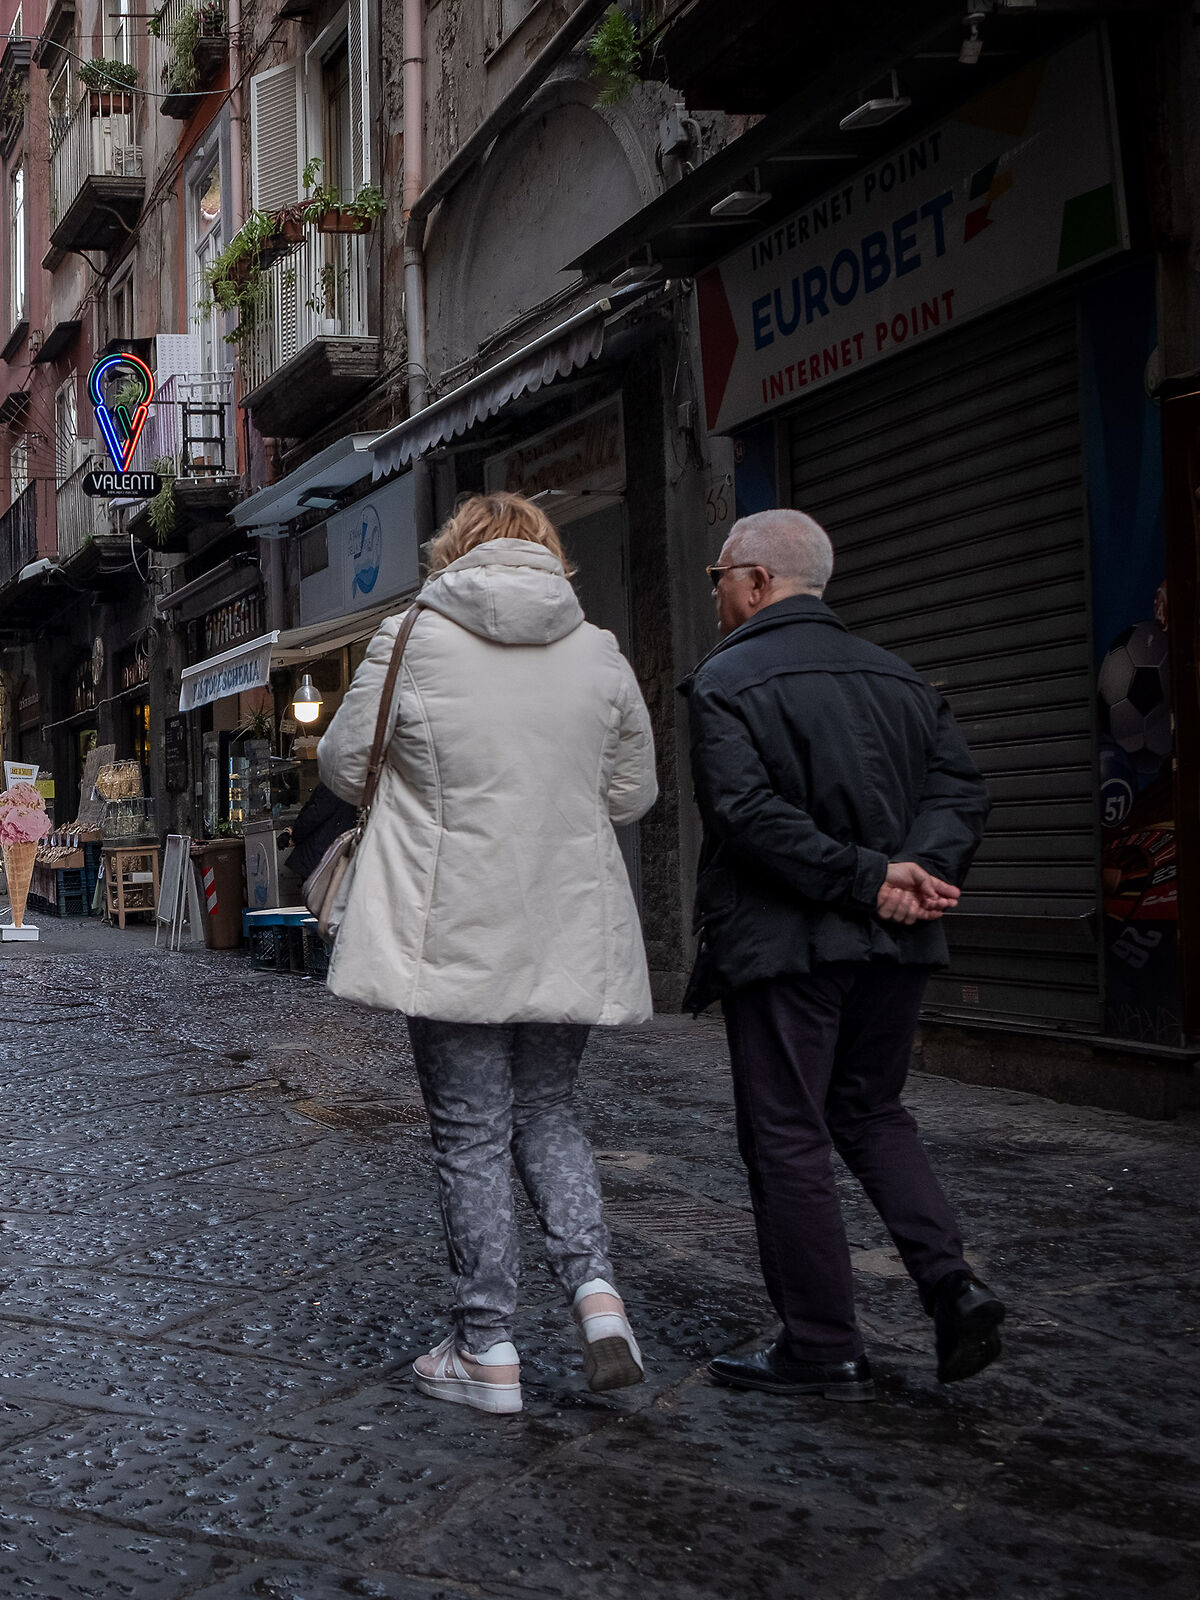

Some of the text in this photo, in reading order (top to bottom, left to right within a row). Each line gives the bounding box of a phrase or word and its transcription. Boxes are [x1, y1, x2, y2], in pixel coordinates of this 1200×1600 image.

[751, 131, 943, 271] INTERNET POINT
[752, 191, 955, 351] EUROBET
[761, 289, 956, 403] INTERNET POINT
[91, 474, 154, 490] VALENTI
[1104, 795, 1125, 821] 51
